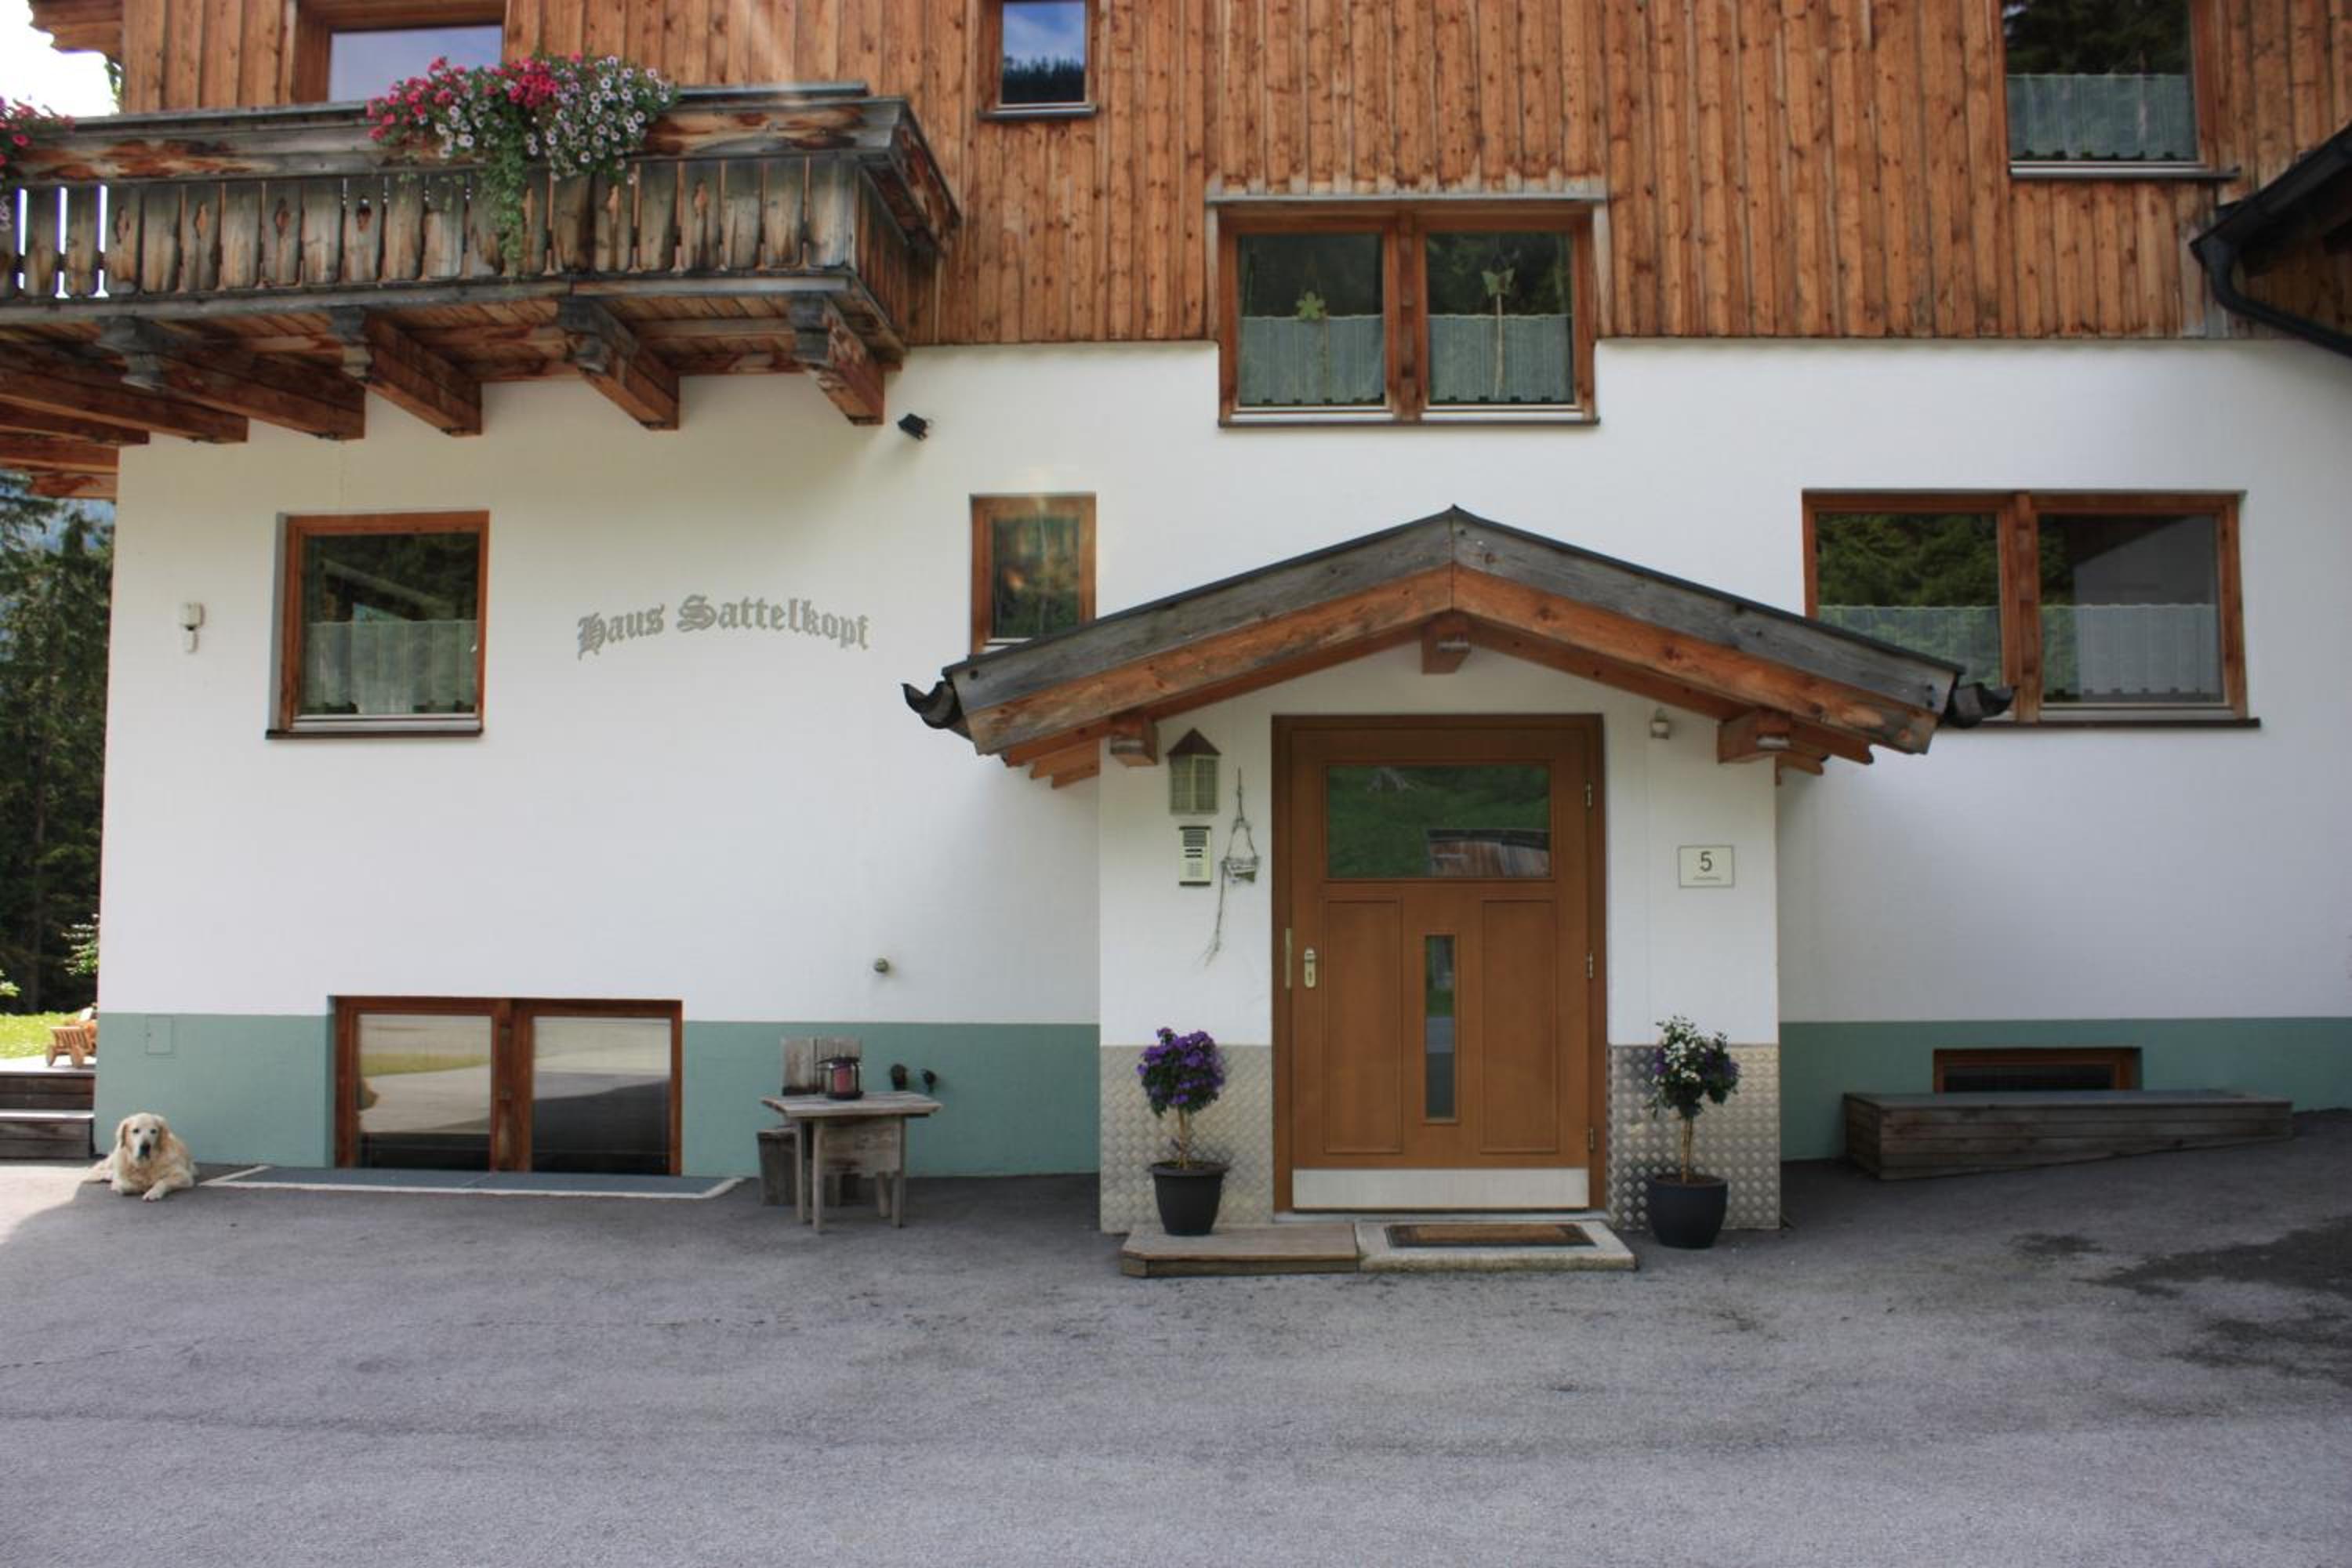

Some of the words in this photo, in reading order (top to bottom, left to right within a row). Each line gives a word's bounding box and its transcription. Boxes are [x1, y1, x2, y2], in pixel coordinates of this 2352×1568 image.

[577, 603, 665, 660] Haus
[676, 593, 869, 650] Sattelkopf
[1700, 851, 1712, 872] 5
